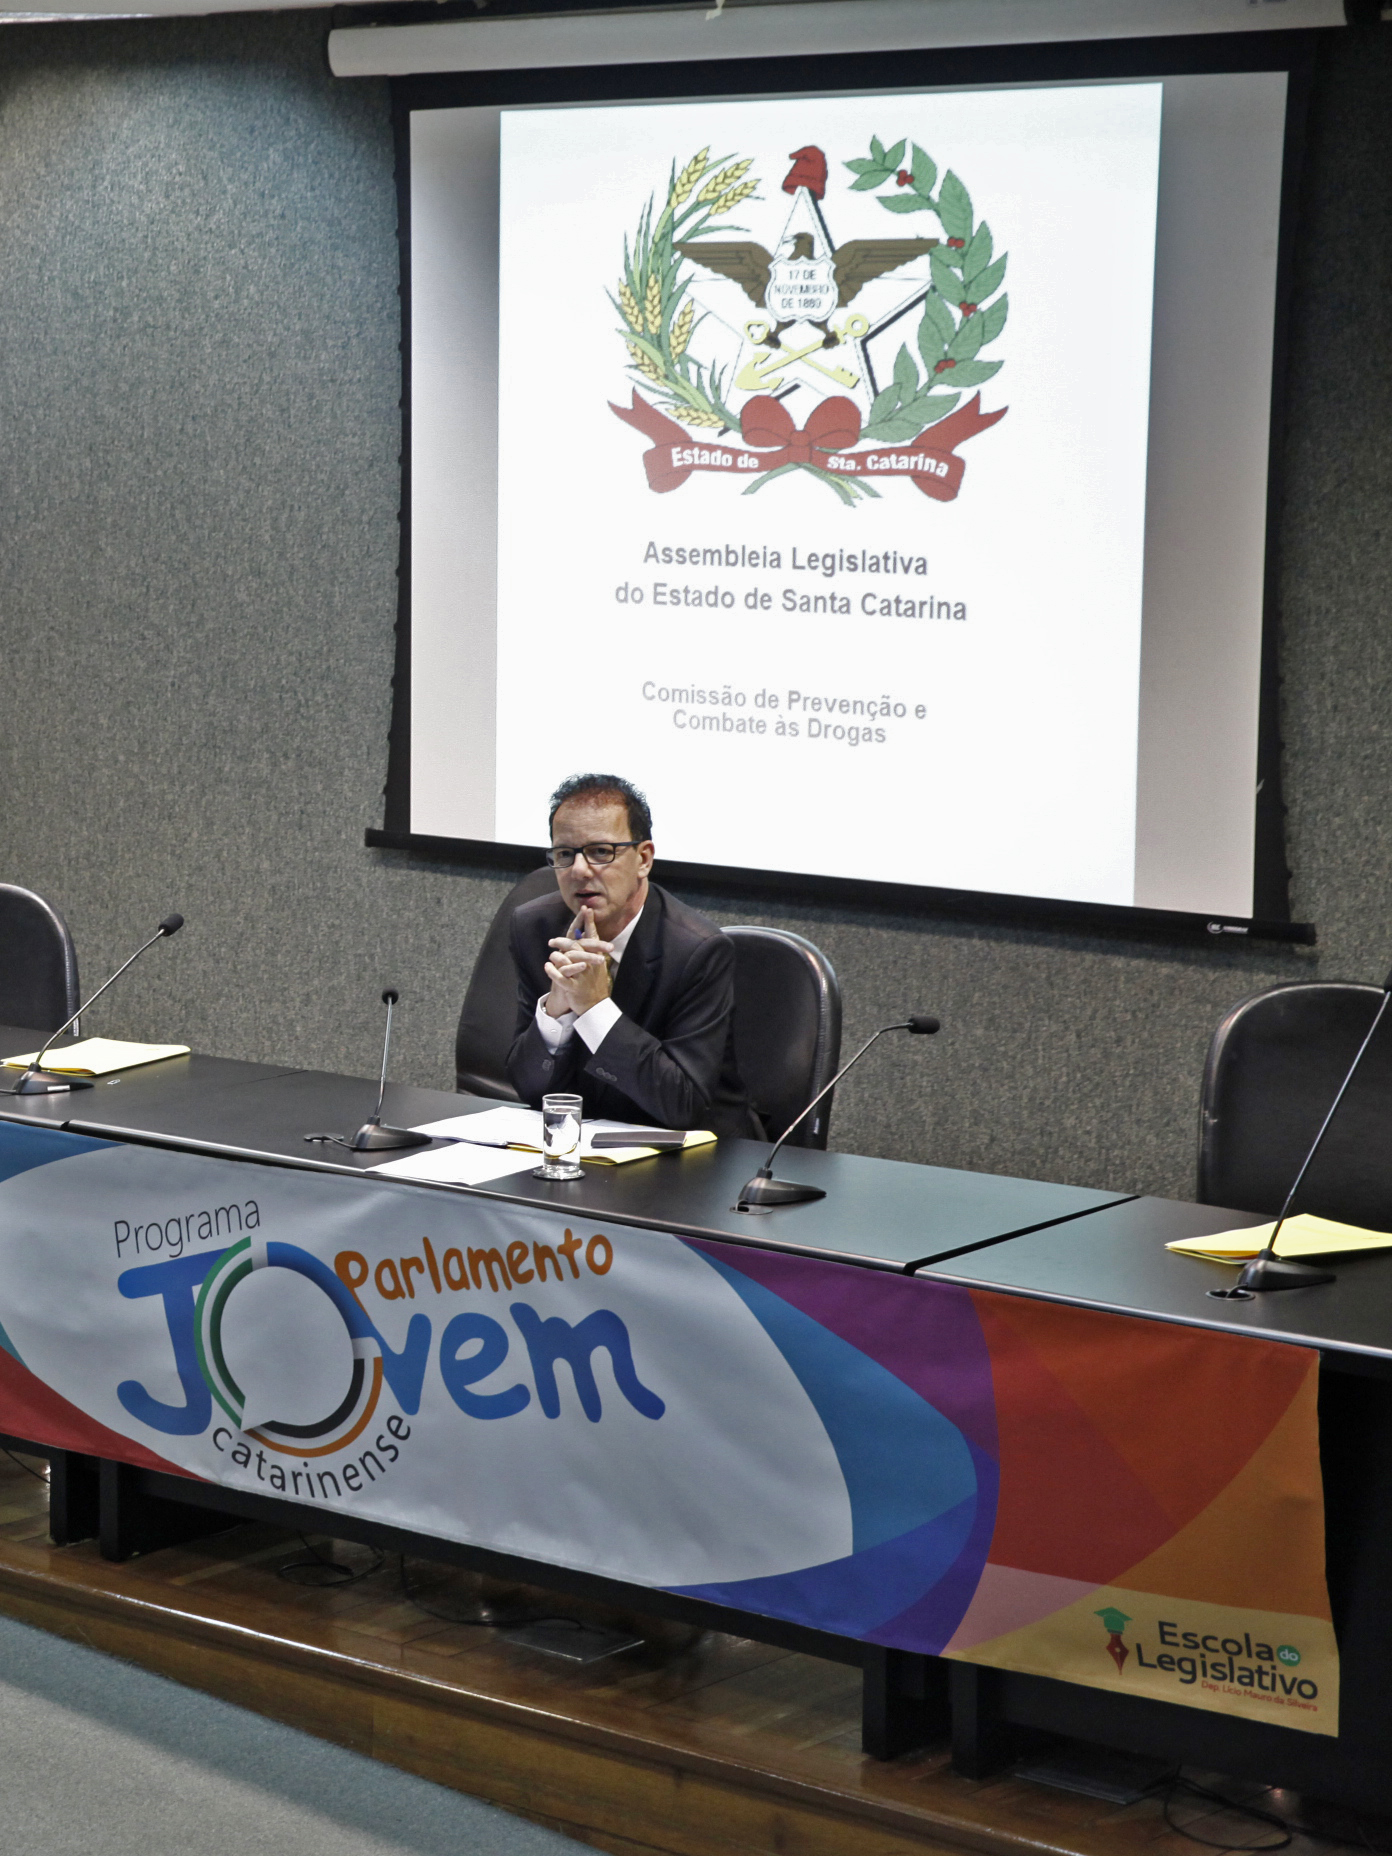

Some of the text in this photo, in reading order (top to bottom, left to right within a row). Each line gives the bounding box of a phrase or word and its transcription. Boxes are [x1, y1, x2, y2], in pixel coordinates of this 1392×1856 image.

[803, 269, 817, 280] DE
[781, 298, 795, 309] DE
[671, 446, 950, 478] Estado de Sta. Catarina
[643, 541, 928, 578] Assembleia Legislativa
[615, 582, 968, 622] do Estado de Santa Catarina
[642, 681, 927, 721] Comissão de Prevenção e
[673, 708, 886, 747] Combate às Drogas
[113, 1199, 261, 1259] Programa
[333, 1227, 614, 1312] Parlamento
[211, 1414, 412, 1499] catarinense
[1158, 1620, 1299, 1662] Escola do
[1135, 1642, 1318, 1700] Legislativo
